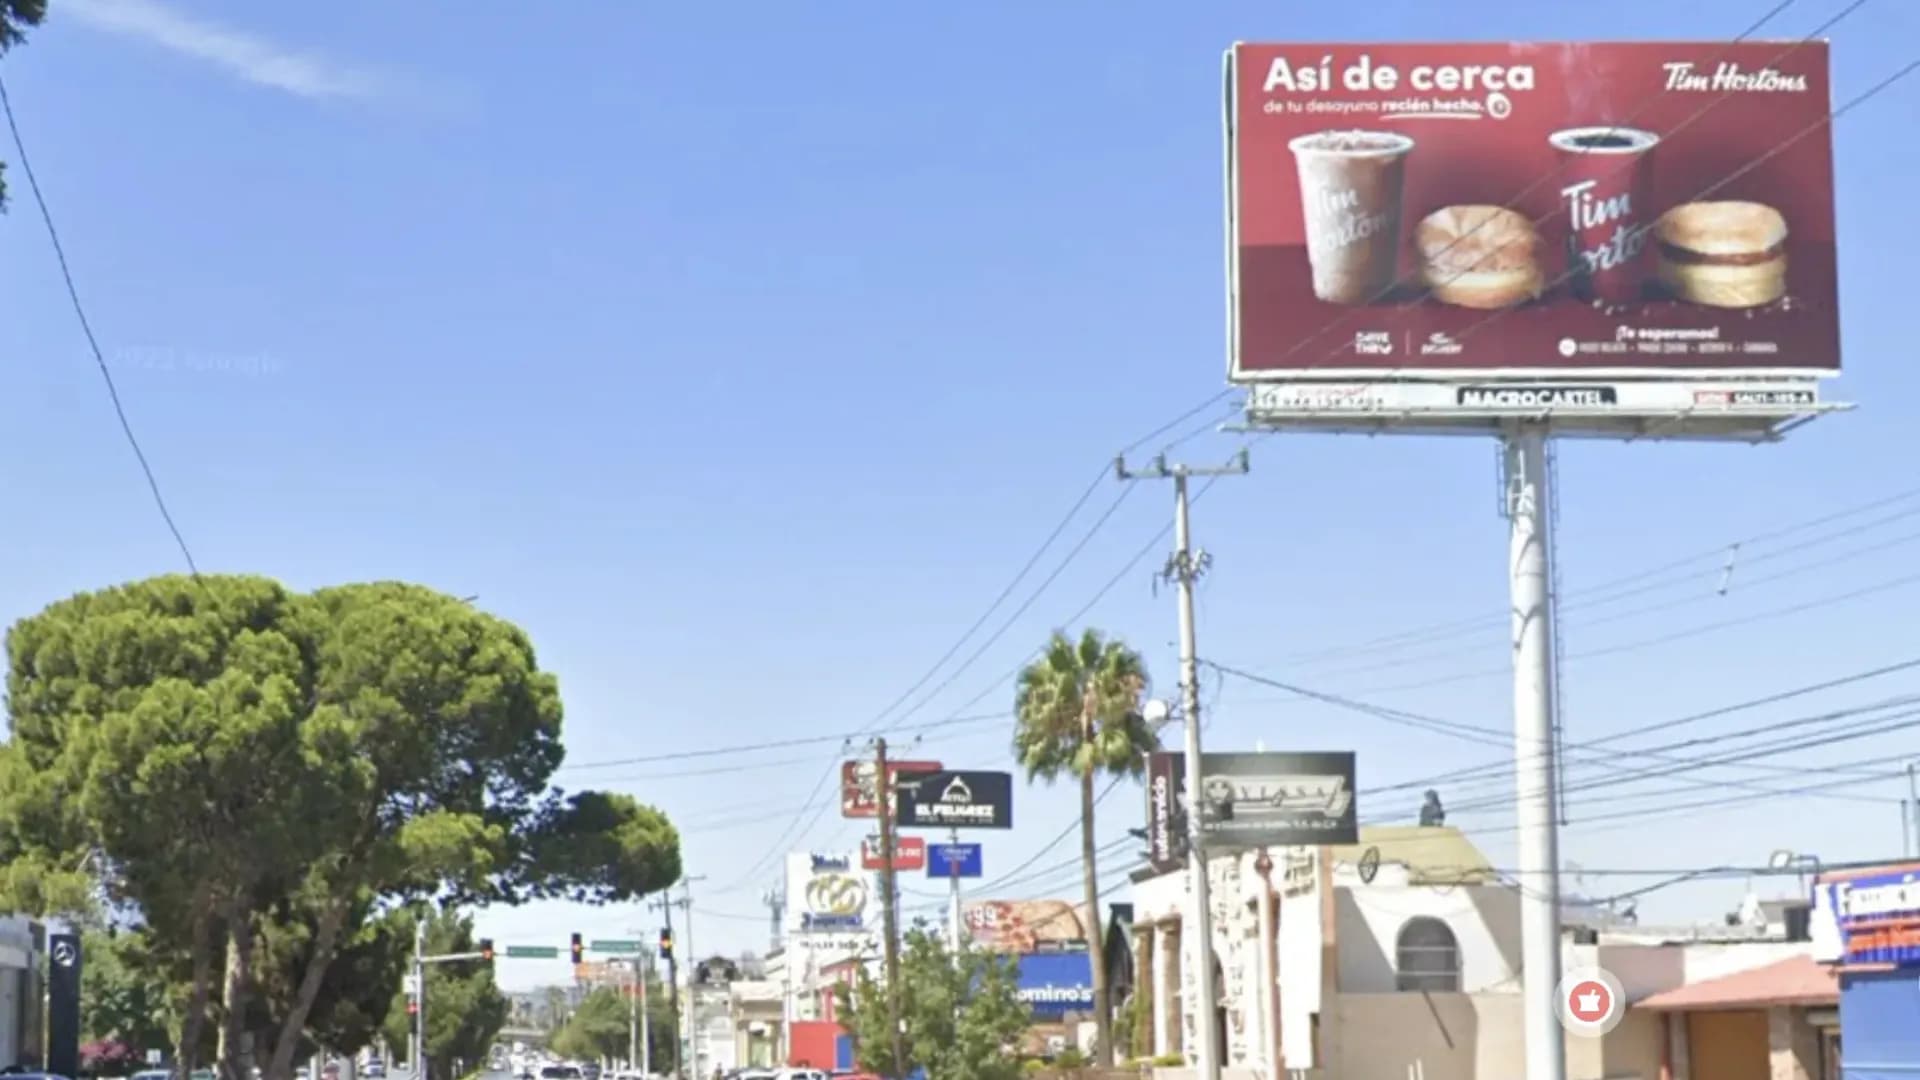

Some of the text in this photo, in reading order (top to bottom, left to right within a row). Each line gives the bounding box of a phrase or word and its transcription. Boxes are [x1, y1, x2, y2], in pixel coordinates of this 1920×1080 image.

[1263, 55, 1535, 91] Así de cerca
[1663, 62, 1808, 91] Tim Hortons
[1264, 99, 1282, 113] de
[1287, 99, 1302, 113] tu
[1306, 99, 1378, 116] desayuno
[1381, 96, 1430, 112] recién
[1561, 179, 1632, 231] Tim
[1012, 982, 1091, 1003] omino's
